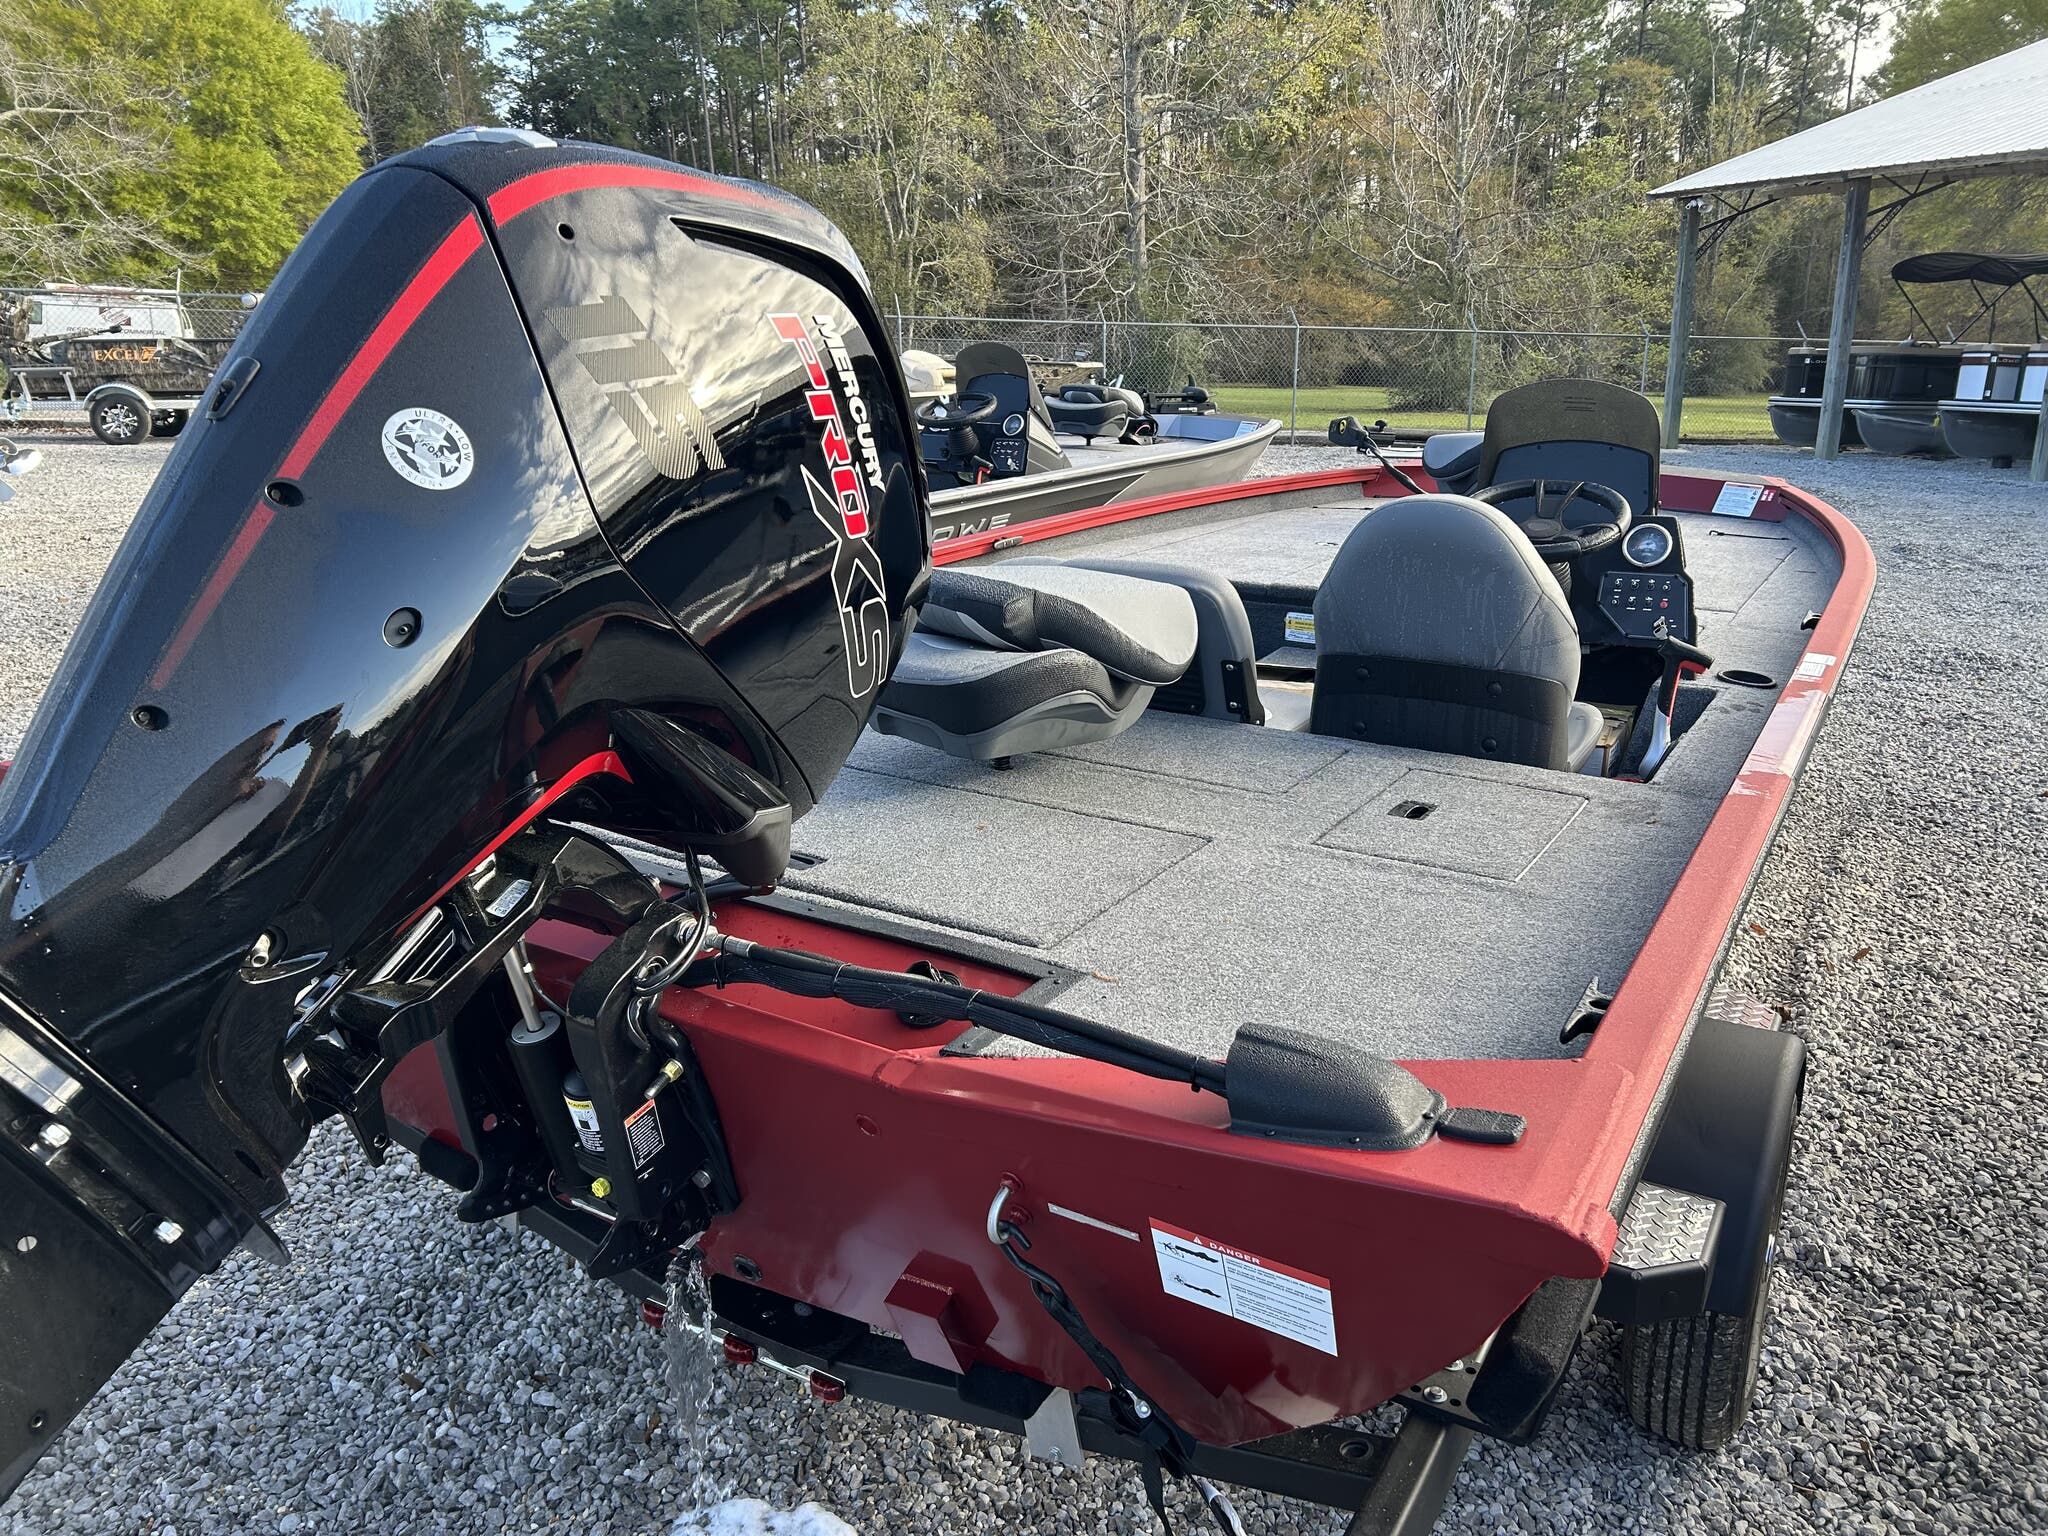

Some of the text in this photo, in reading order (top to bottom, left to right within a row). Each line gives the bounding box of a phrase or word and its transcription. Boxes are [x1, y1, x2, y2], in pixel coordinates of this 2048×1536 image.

[812, 314, 886, 493] MERCURY
[414, 409, 472, 462] ULTRA LOW
[384, 444, 436, 488] EMISSION
[766, 312, 890, 699] PRO XS
[932, 512, 1012, 543] OWE
[1209, 1241, 1261, 1265] DANGER
